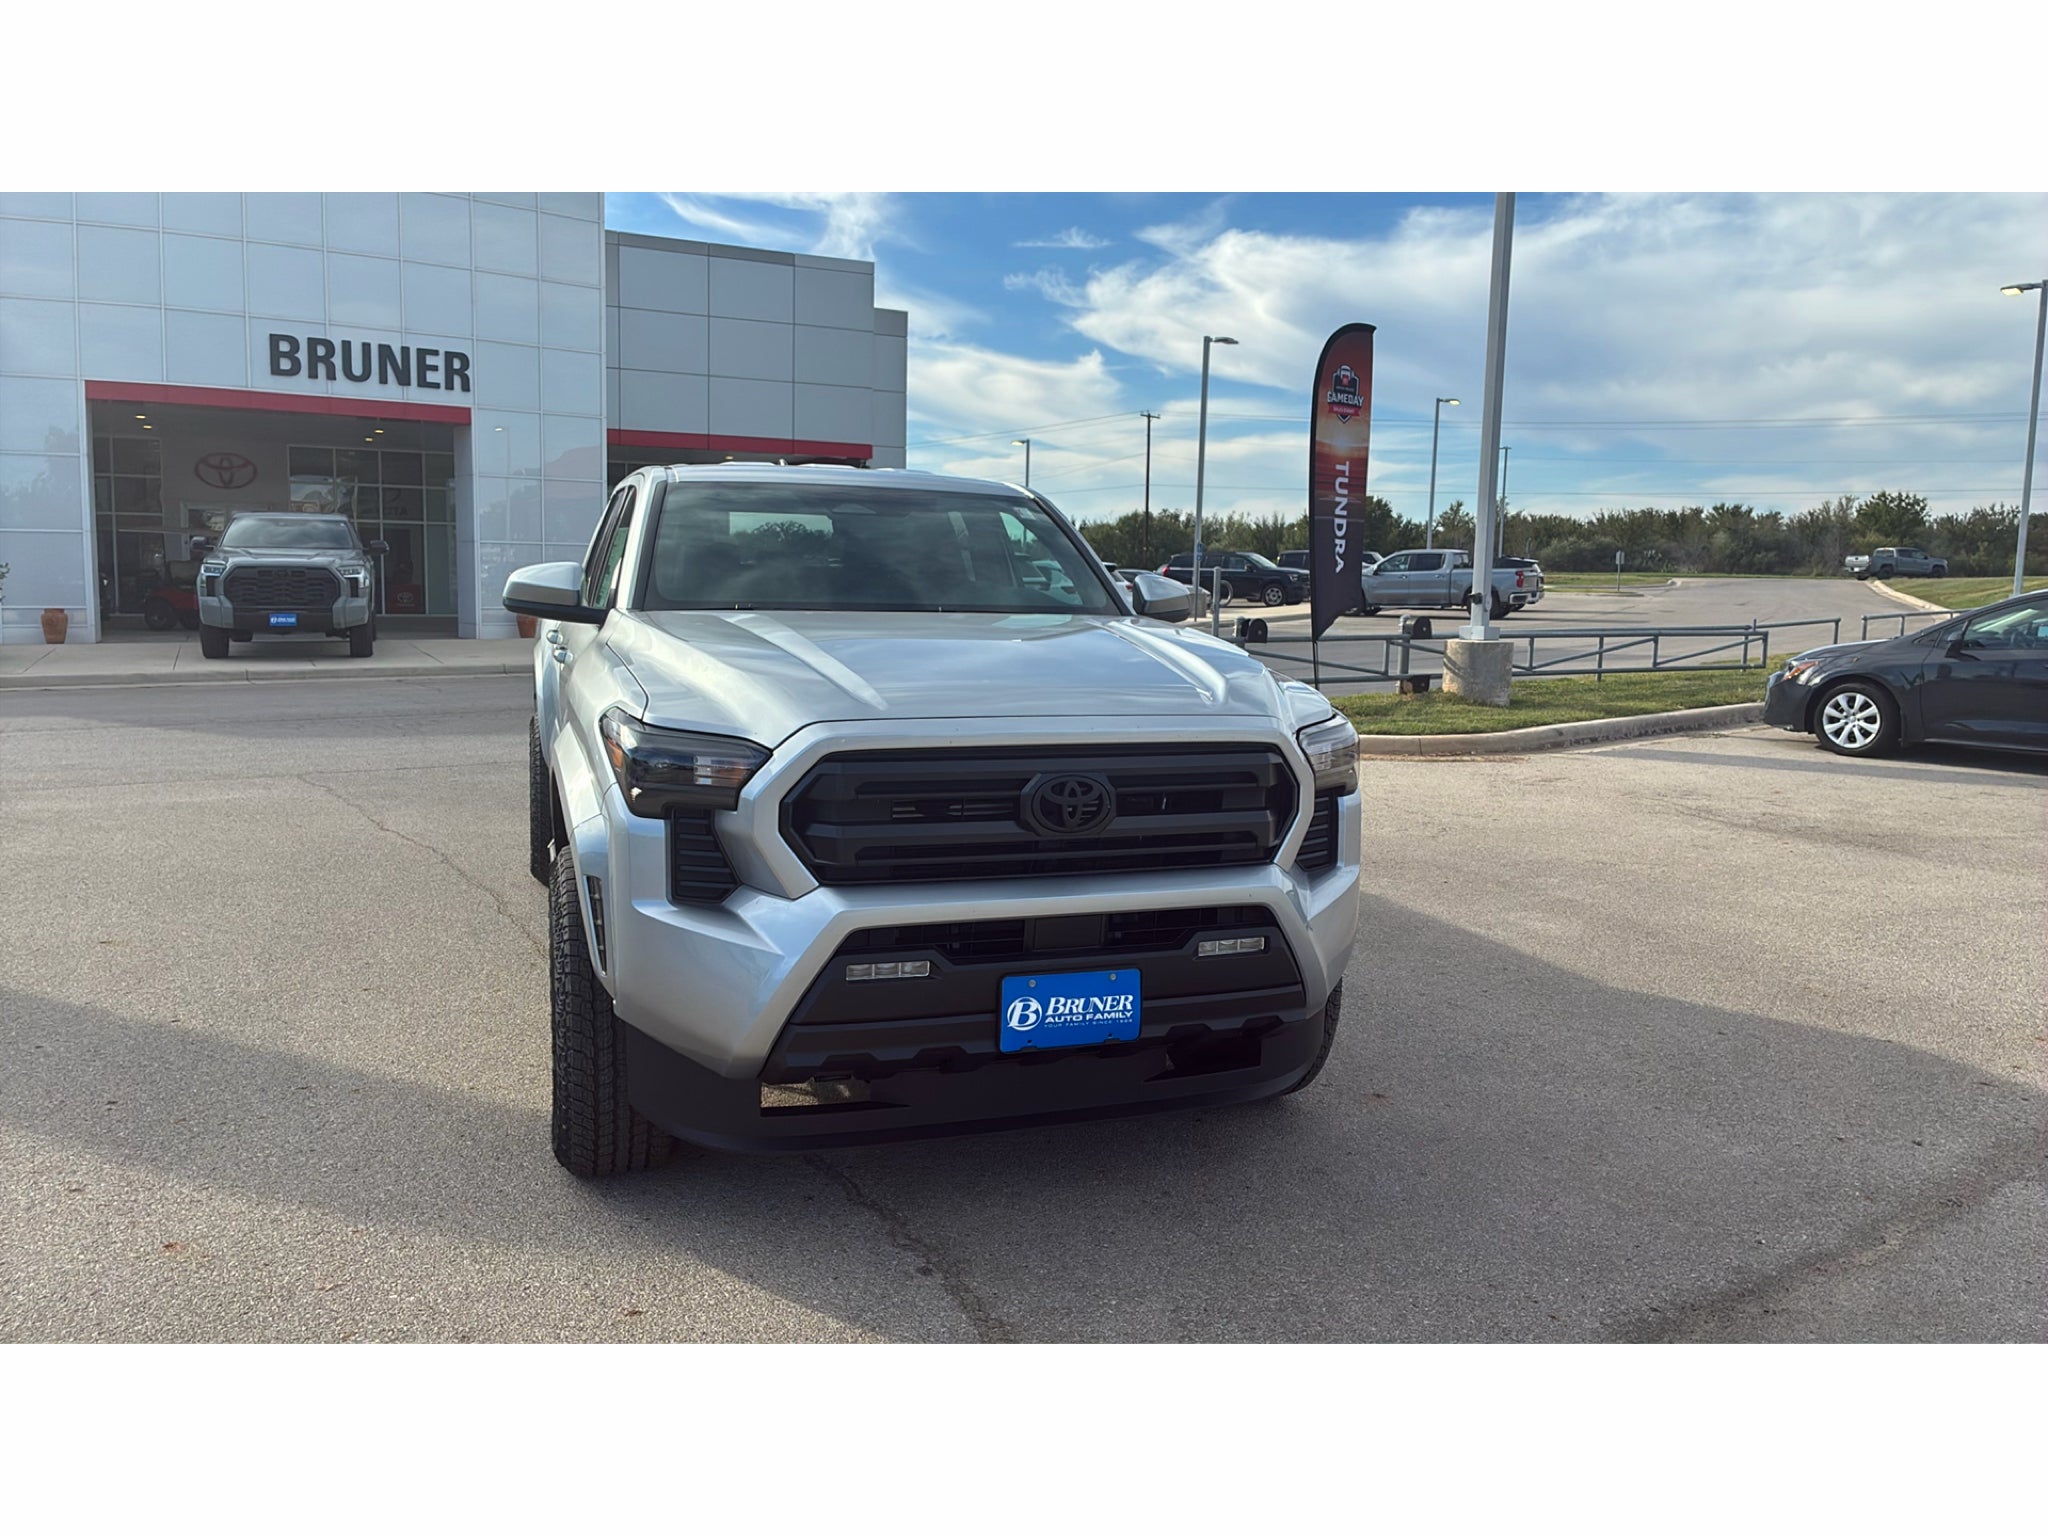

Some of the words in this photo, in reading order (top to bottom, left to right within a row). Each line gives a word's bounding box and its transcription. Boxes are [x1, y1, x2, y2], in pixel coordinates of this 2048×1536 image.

[269, 333, 470, 392] BRUNER
[1327, 391, 1364, 406] GAMEDAY
[1333, 460, 1350, 574] TUNDRA
[1045, 994, 1134, 1016] BRUNER
[1045, 1013, 1083, 1024] AUTO
[1086, 1010, 1134, 1021] FAMILY
